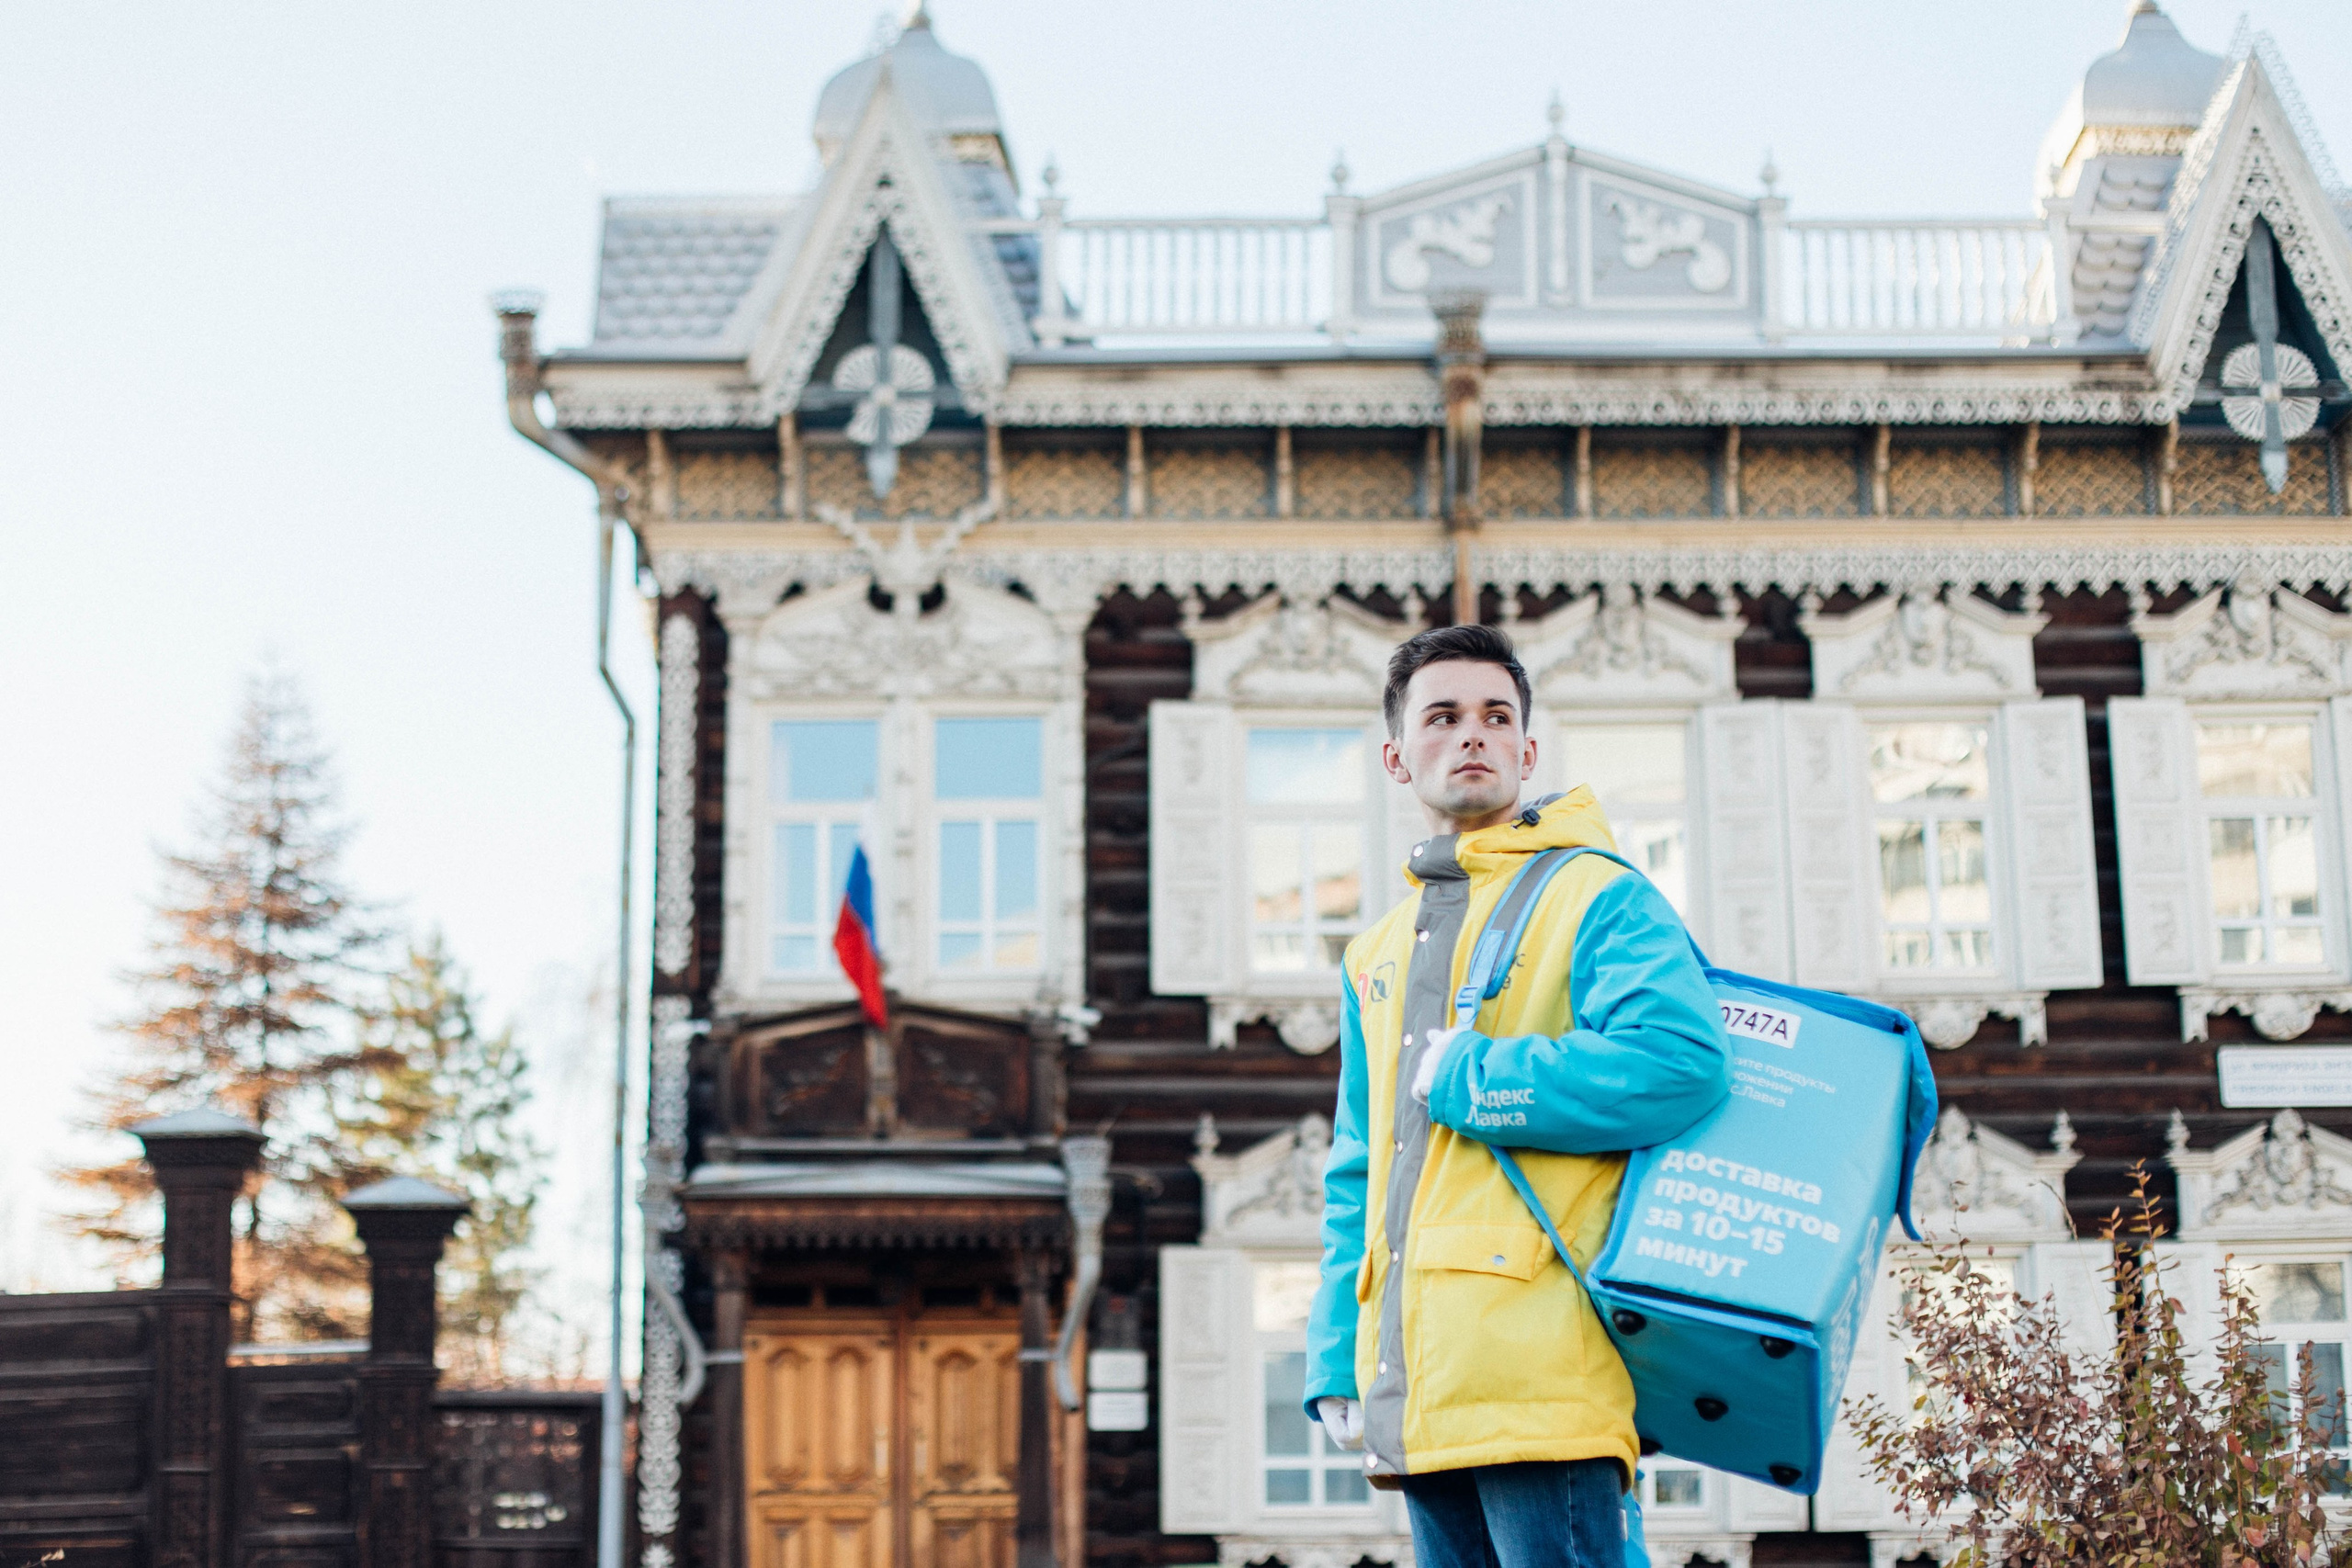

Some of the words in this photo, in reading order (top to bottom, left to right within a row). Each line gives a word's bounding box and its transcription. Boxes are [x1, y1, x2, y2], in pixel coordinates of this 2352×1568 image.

[1766, 1065, 1836, 1094] продукты
[1464, 1105, 1527, 1126] Лавка
[1659, 1150, 1822, 1205] доставка
[1645, 1207, 1683, 1231] за
[1655, 1179, 1840, 1244] продуктов
[1636, 1236, 1748, 1278] минут
